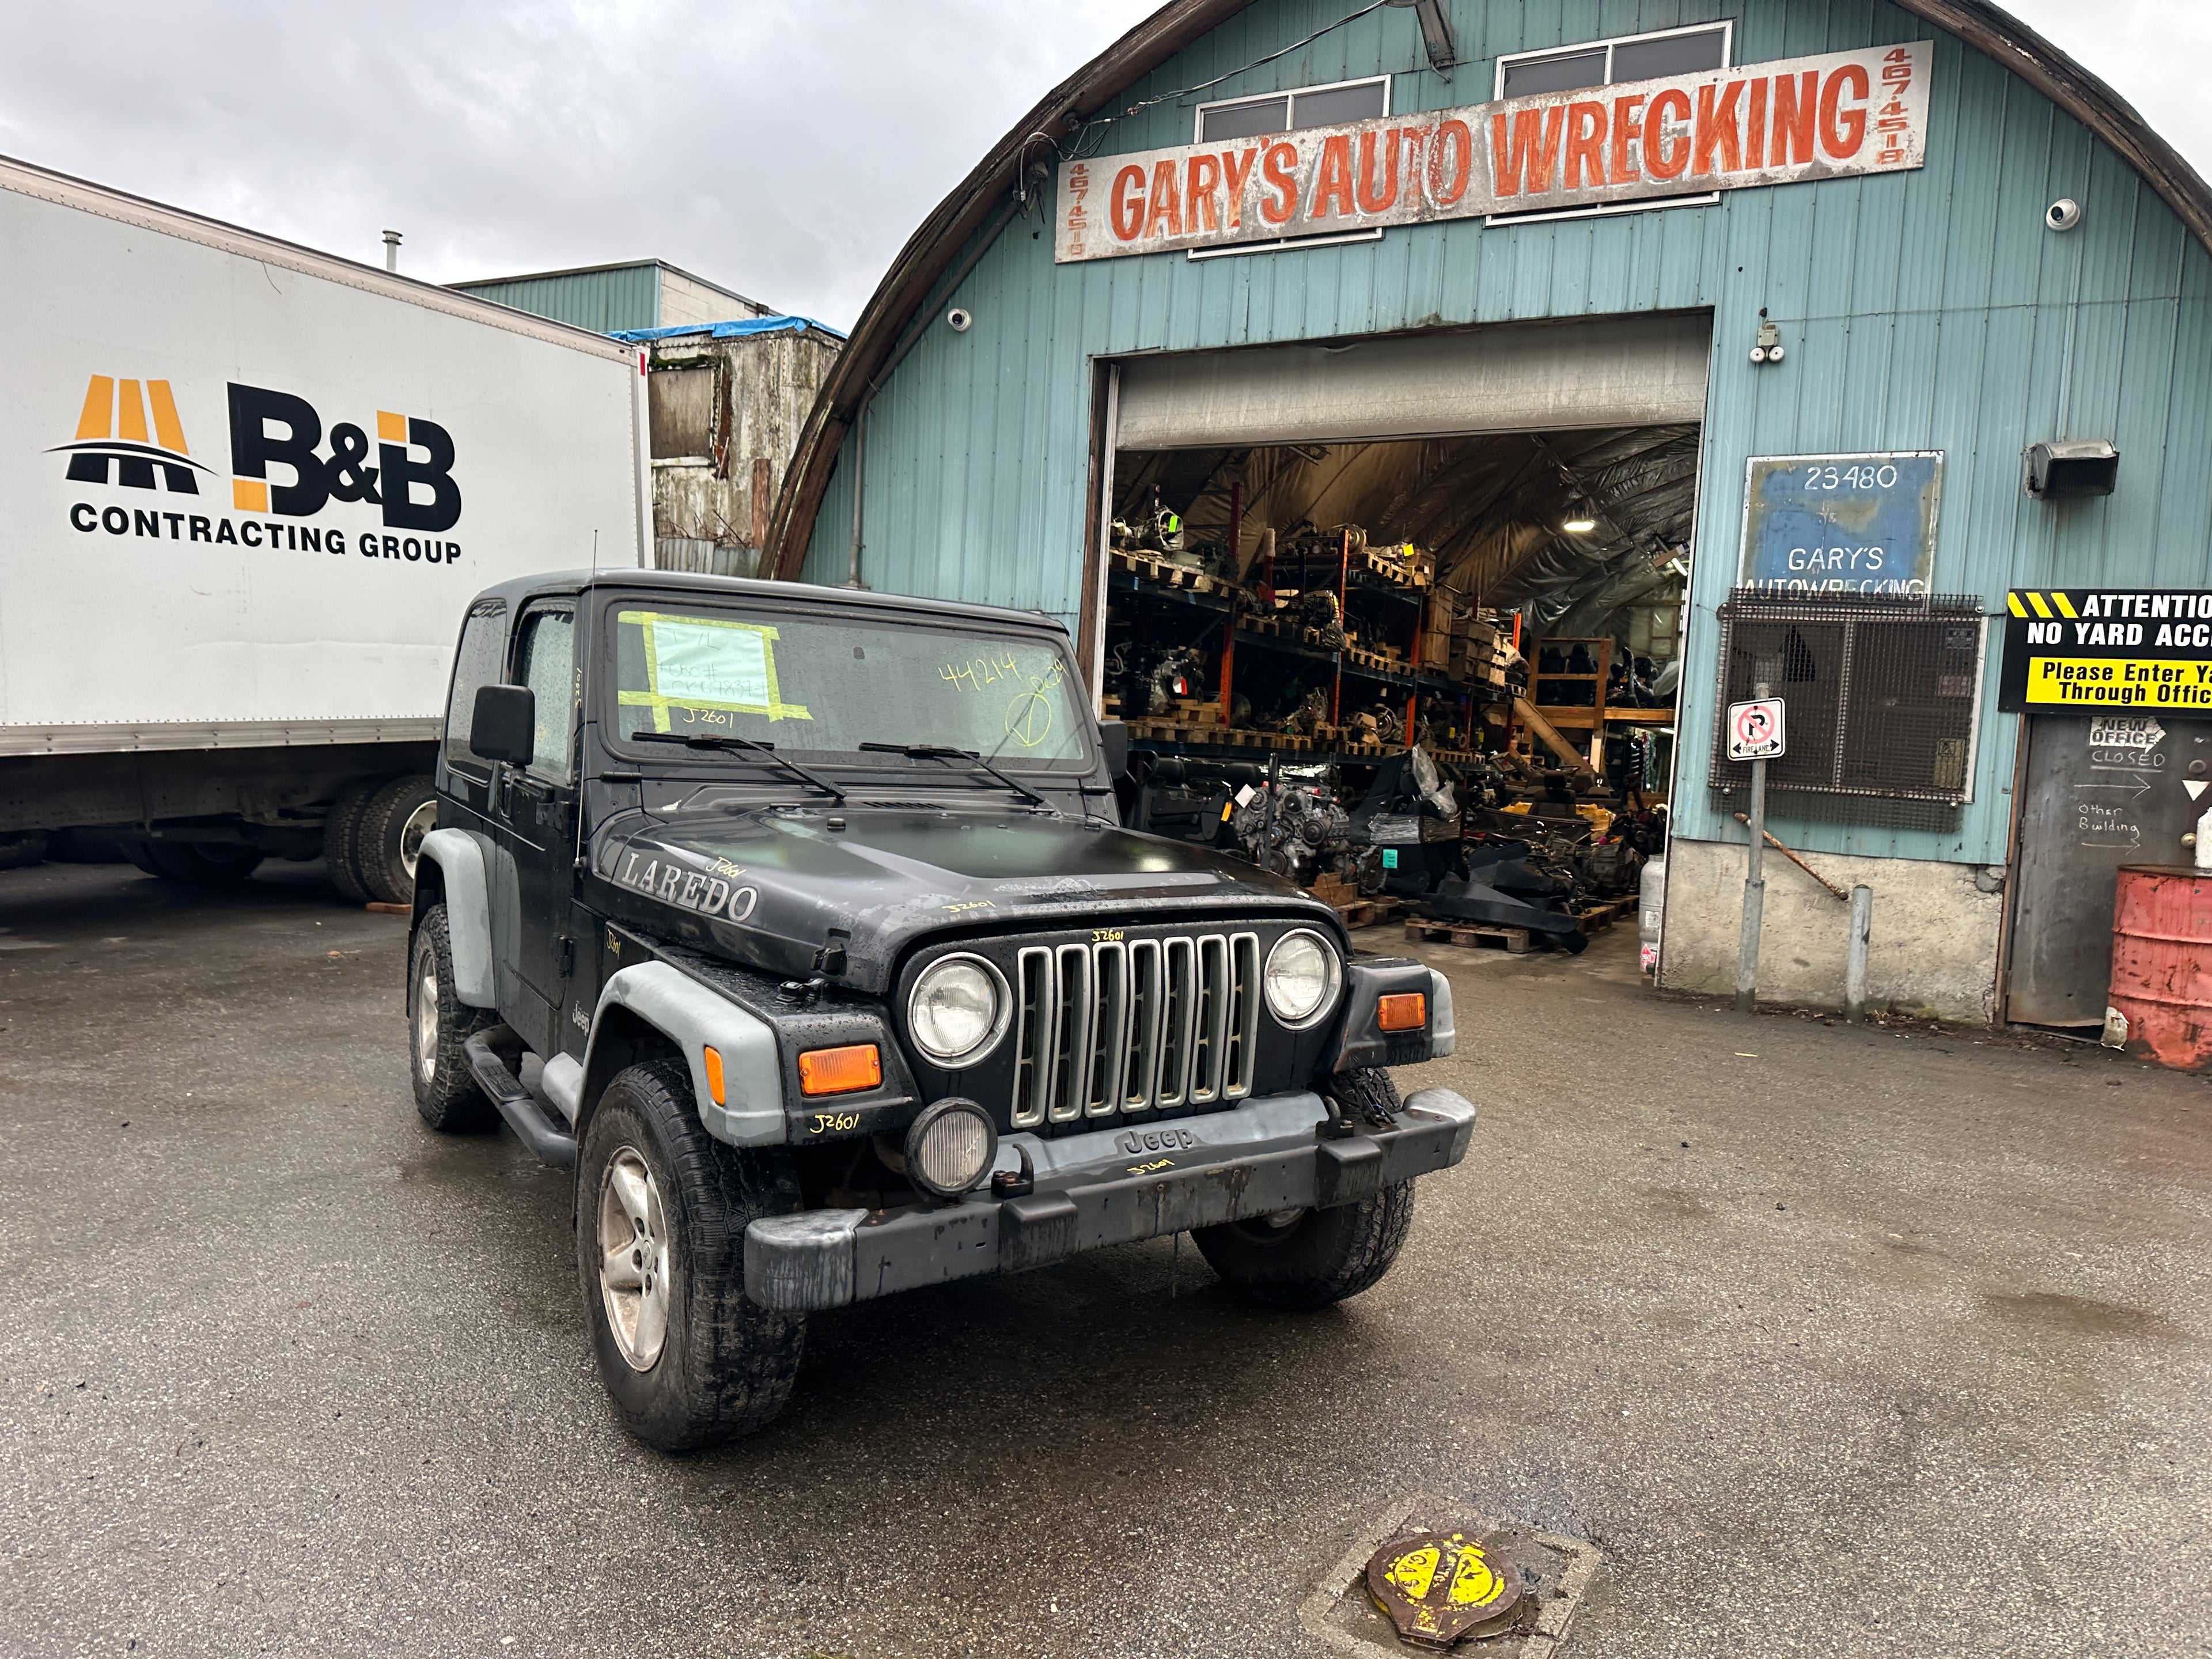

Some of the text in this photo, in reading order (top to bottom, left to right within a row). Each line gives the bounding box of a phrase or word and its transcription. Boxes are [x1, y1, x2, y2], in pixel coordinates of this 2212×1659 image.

[1109, 64, 1870, 241] GARY'S AUTO WRECKING
[227, 381, 462, 532] B&B
[1804, 465, 1897, 490] 23480
[70, 503, 462, 565] CONTRACTING GROUP
[1788, 547, 1884, 570] GARY'S
[2081, 594, 2212, 619] ATTENTIO
[2027, 622, 2212, 647] NO YARD ACC
[938, 653, 1022, 692] 44214
[2043, 662, 2113, 681] Please
[2124, 664, 2185, 683] Enter
[2059, 681, 2211, 704] Through Offic
[683, 707, 733, 728] J2601
[2101, 718, 2147, 732] NEW
[1755, 744, 1770, 752] LANE
[2092, 729, 2156, 745] OFFICE
[2092, 750, 2165, 766] CLOSED
[2079, 817, 2141, 840] Building
[622, 851, 759, 922] LAREDO
[941, 900, 997, 913] J2601
[1092, 930, 1124, 942] J2601
[572, 1001, 590, 1037] Jeep
[809, 1112, 859, 1134] J2601
[1124, 1128, 1193, 1154] Jeep
[1399, 1554, 1427, 1588] GAS
